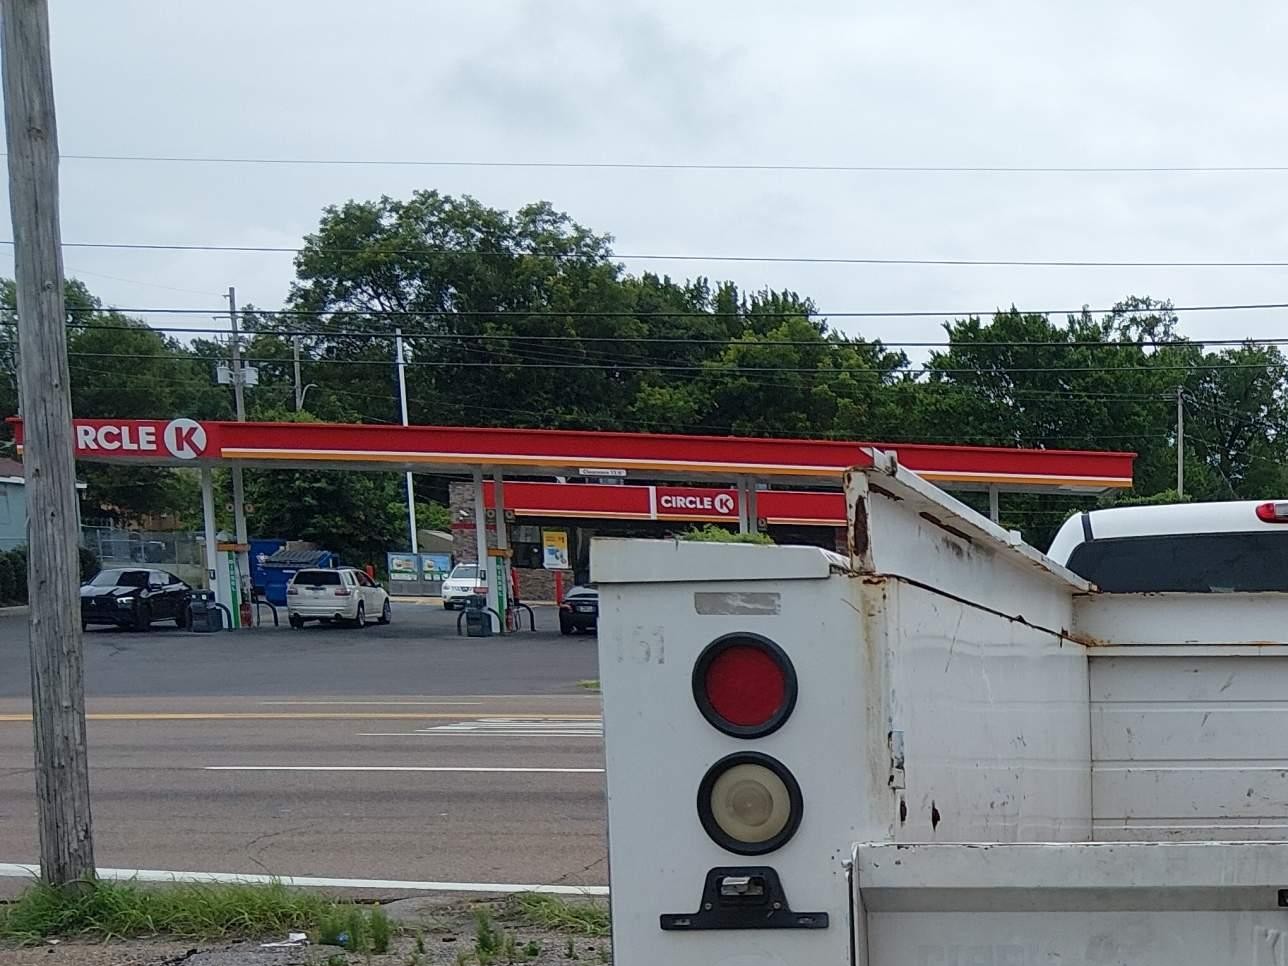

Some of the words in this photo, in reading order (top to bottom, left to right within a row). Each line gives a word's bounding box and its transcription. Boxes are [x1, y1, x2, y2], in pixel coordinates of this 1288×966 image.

[76, 425, 157, 451] RCLE
[170, 422, 206, 457] K
[660, 495, 713, 510] CIRCLE
[717, 495, 734, 513] K
